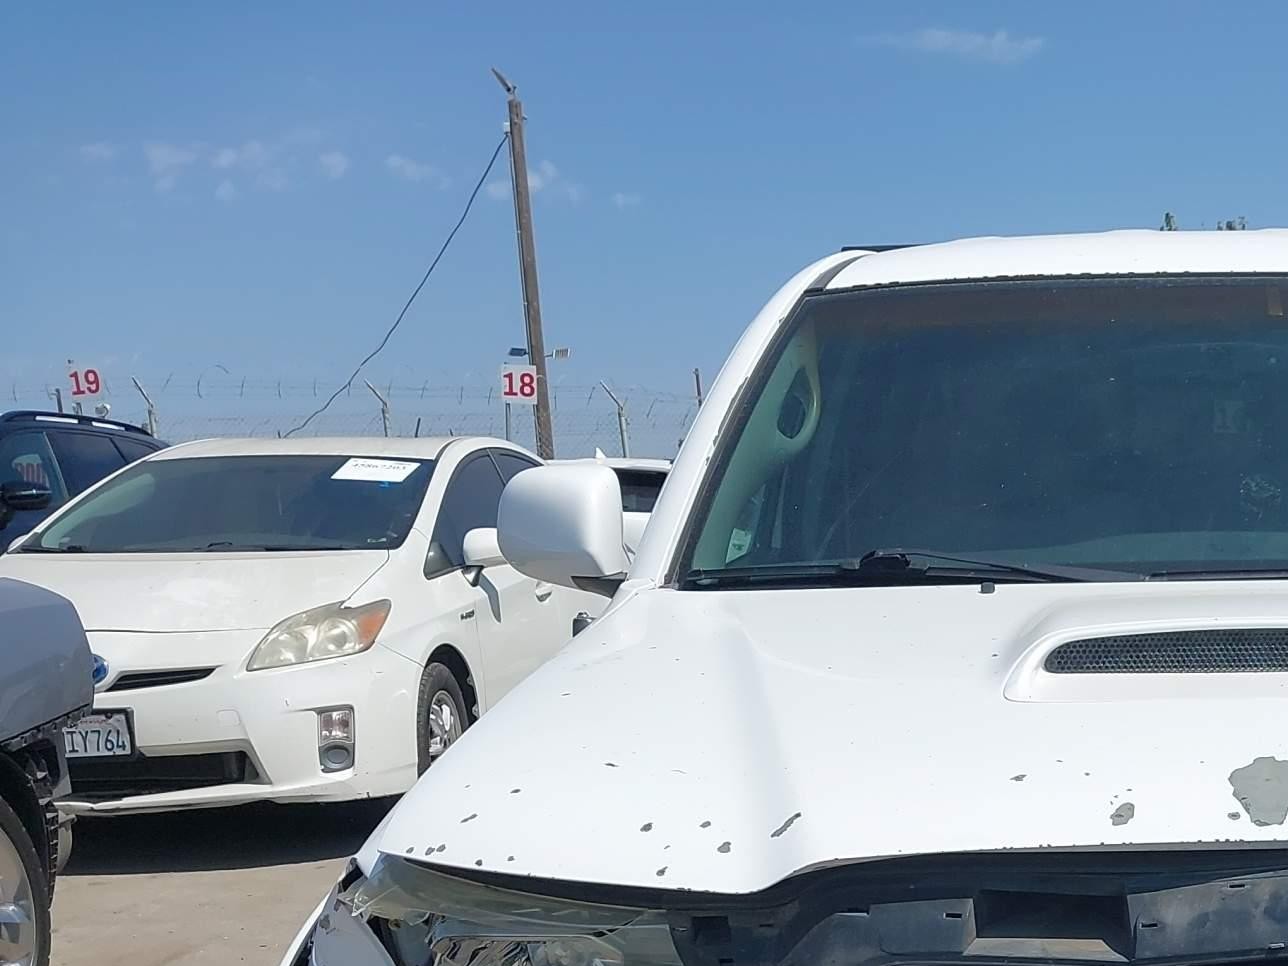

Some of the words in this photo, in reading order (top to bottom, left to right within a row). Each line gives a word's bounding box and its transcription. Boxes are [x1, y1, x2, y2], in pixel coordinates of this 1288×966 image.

[69, 369, 100, 395] 19
[503, 372, 535, 397] 18
[65, 729, 127, 753] IY764
